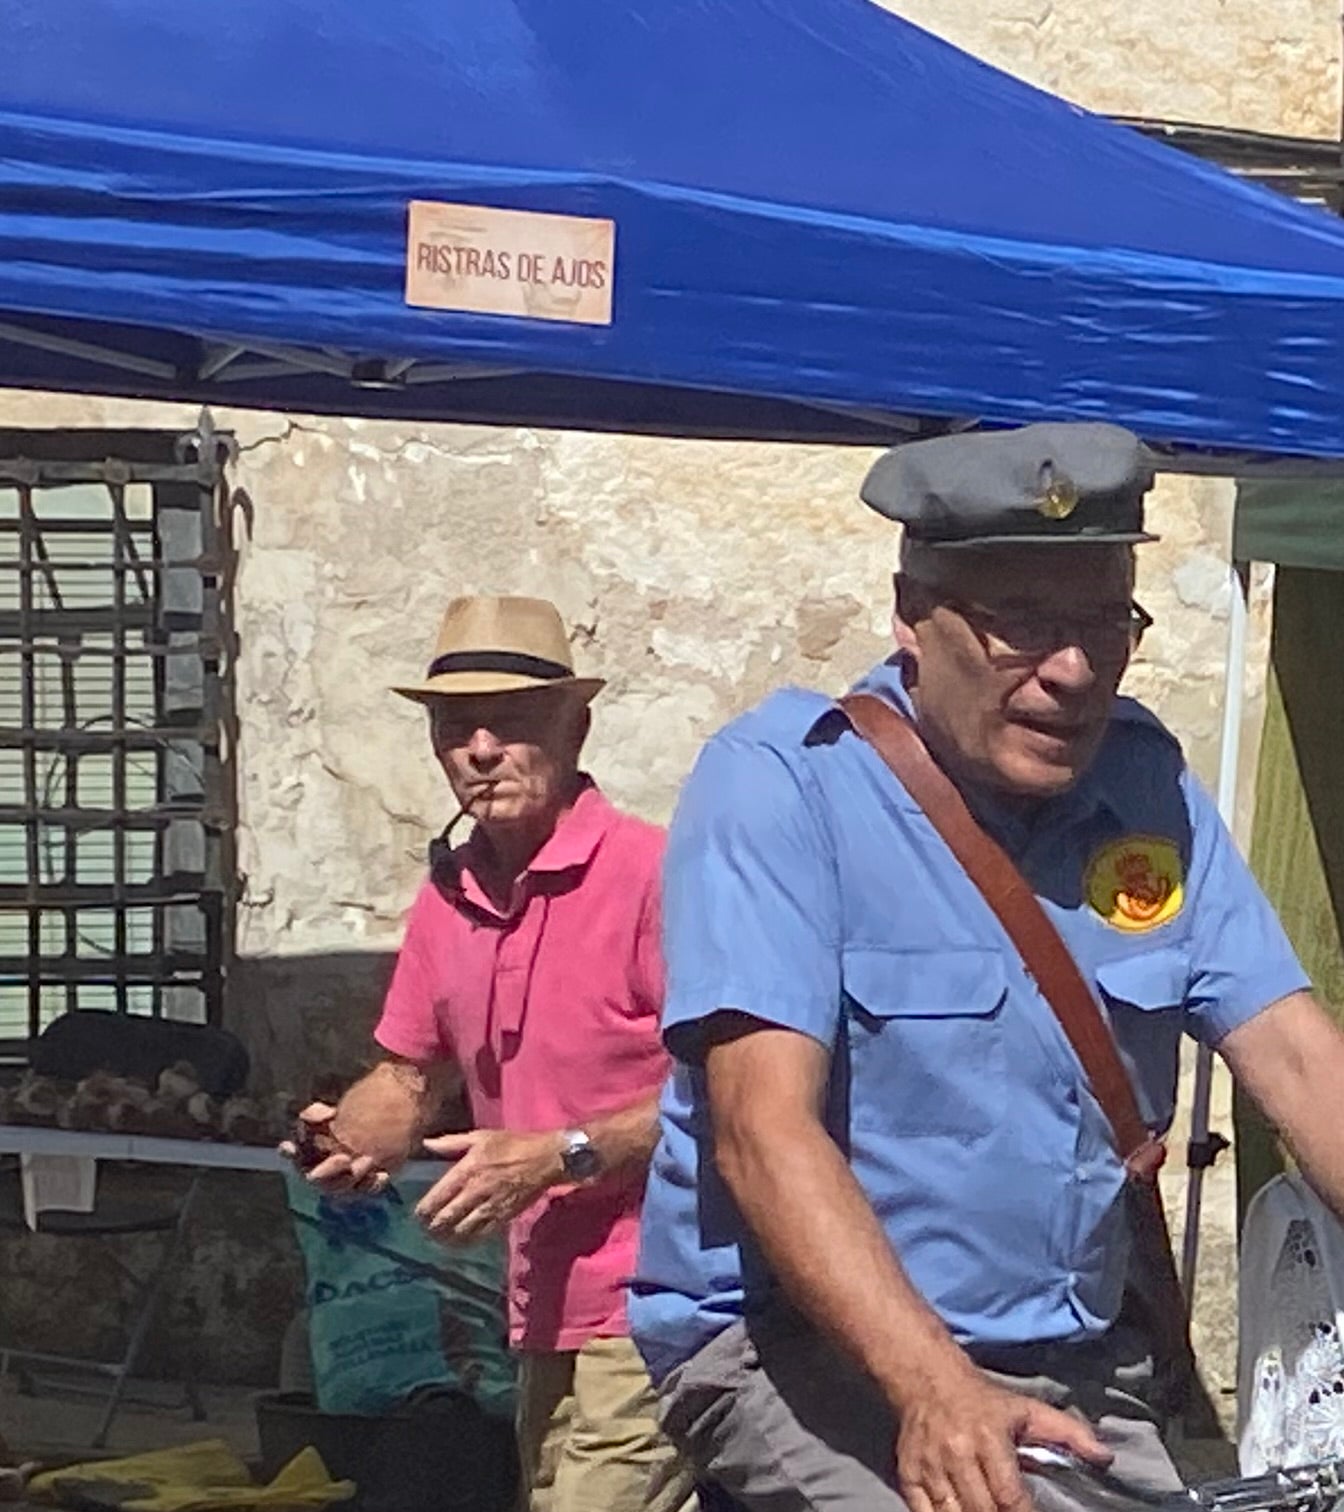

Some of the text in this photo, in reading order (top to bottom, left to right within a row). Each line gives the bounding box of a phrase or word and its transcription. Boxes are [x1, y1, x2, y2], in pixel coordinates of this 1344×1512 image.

[417, 242, 605, 289] RISTRAS DE AJOS
